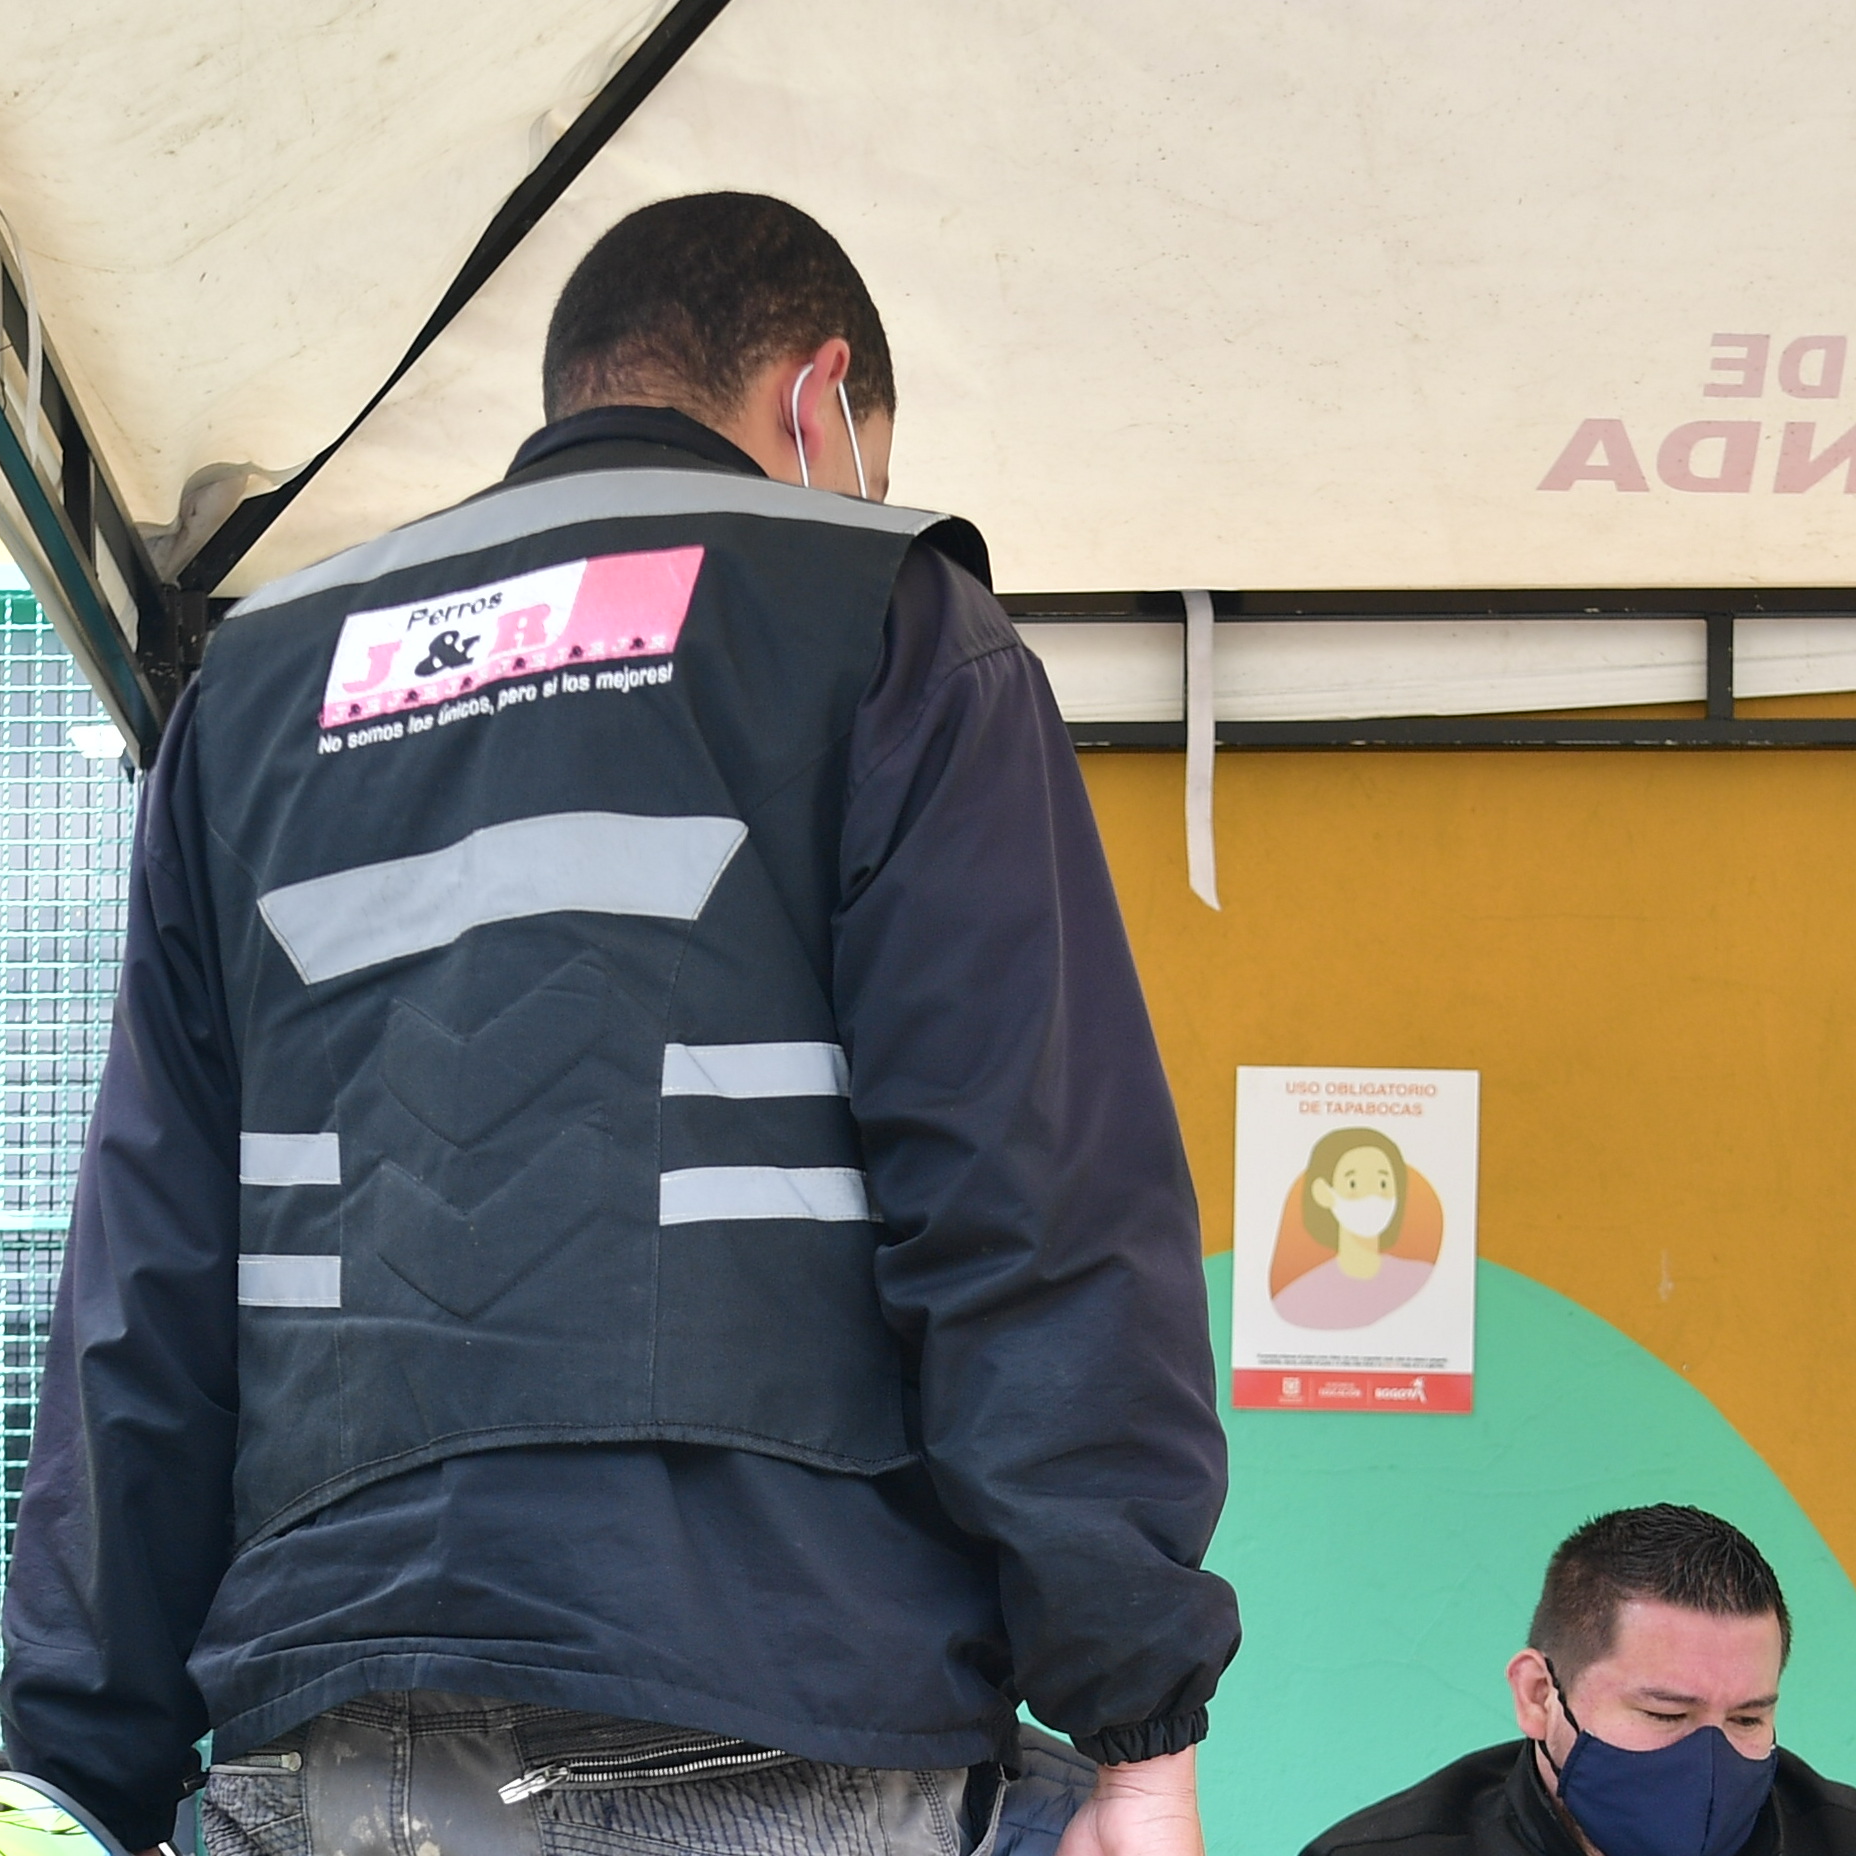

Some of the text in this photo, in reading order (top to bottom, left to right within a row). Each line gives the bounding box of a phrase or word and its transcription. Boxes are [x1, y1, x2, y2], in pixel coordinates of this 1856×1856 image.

[405, 592, 504, 631] Perros
[342, 640, 401, 693] J
[414, 629, 480, 677] &
[318, 733, 342, 754] No
[347, 720, 404, 749] somos
[407, 714, 434, 735] los
[497, 684, 537, 710] pero
[562, 671, 591, 693] los
[1285, 1081, 1438, 1098] USO OBLIGATORIO
[1299, 1101, 1424, 1117] DE TAPABOCAS
